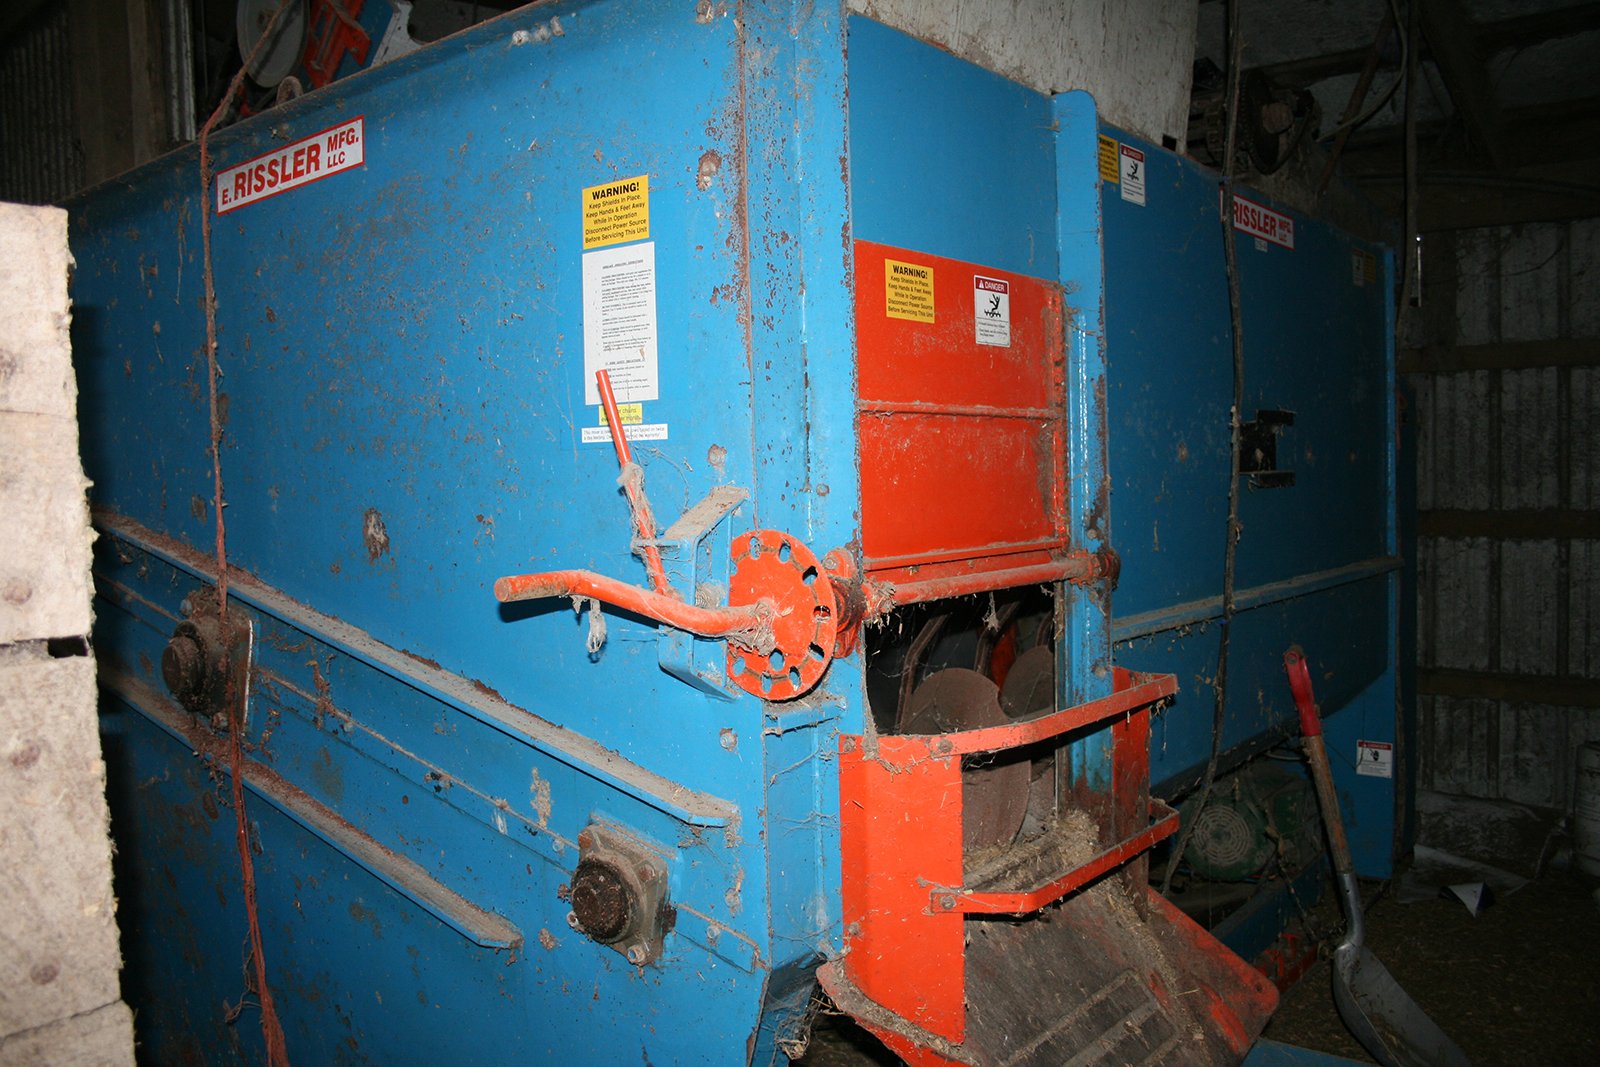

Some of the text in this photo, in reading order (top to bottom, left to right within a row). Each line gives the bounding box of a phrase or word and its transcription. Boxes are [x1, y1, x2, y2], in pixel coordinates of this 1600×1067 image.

[328, 151, 346, 168] LLC
[222, 128, 359, 205] E. RISSLER MFG.
[592, 182, 640, 200] WARNING!
[602, 198, 620, 207] Shields
[614, 212, 638, 222] Operation
[1232, 201, 1276, 238] RISSLER
[586, 225, 612, 235] Disconnect
[613, 222, 628, 230] Power
[602, 232, 624, 240] Servicing
[625, 228, 636, 236] This
[893, 265, 928, 279] WARNING!
[984, 282, 1004, 292] DANGER
[888, 298, 908, 306] Disconnect
[910, 294, 927, 302] Operation
[901, 308, 917, 316] Servicing
